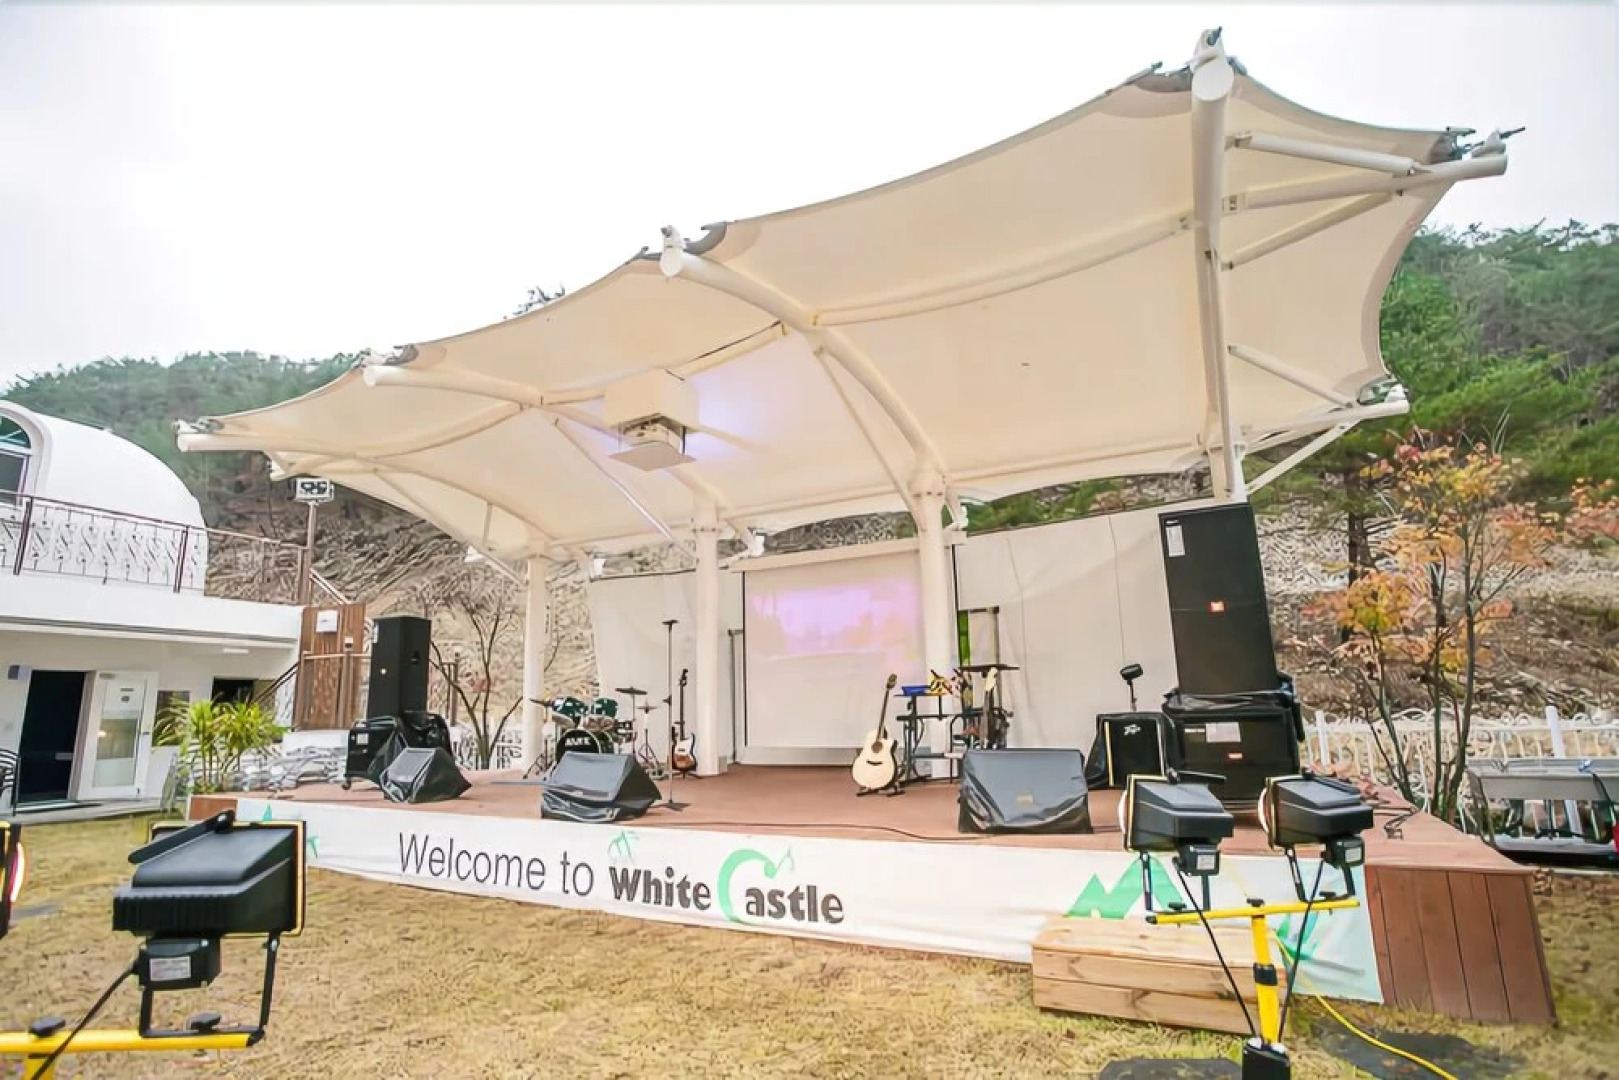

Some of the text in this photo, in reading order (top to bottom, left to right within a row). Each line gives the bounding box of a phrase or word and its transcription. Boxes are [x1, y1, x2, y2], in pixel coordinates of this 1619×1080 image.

[399, 832, 844, 925] Welcome to White Castle
